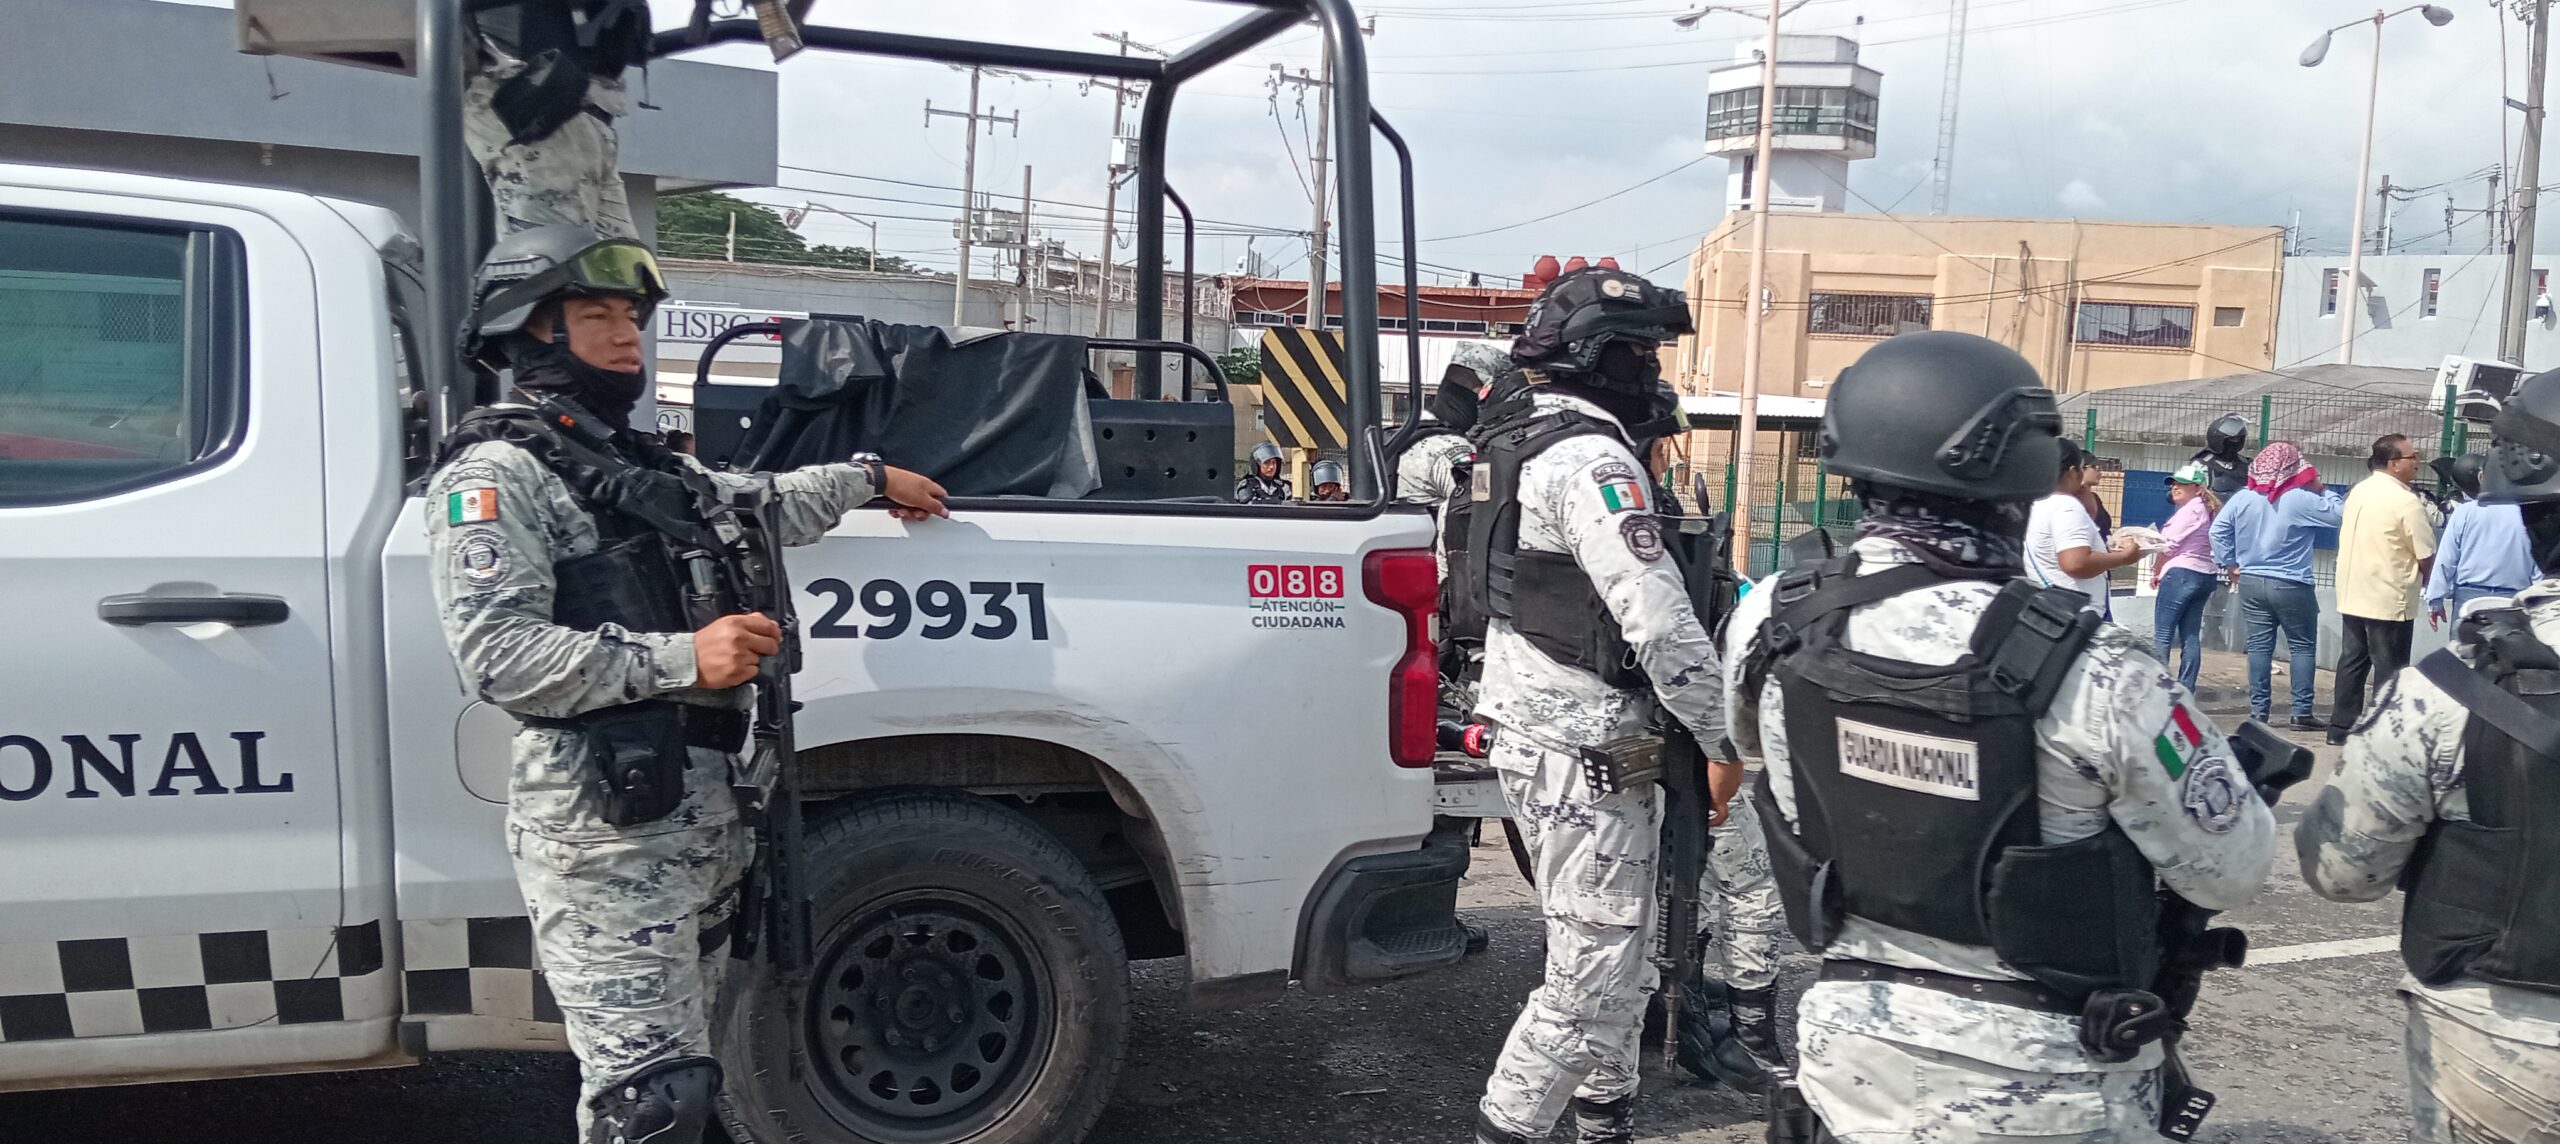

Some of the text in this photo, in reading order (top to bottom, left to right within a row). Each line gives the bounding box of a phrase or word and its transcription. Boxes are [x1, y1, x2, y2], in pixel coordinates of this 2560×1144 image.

[664, 310, 750, 340] HSBC
[1253, 569, 1339, 595] 088
[804, 577, 1049, 641] 29931
[1251, 616, 1345, 628] CIUDADANA
[0, 731, 295, 801] ONAL
[1844, 730, 1974, 790] GUARDIA NACIONAL
